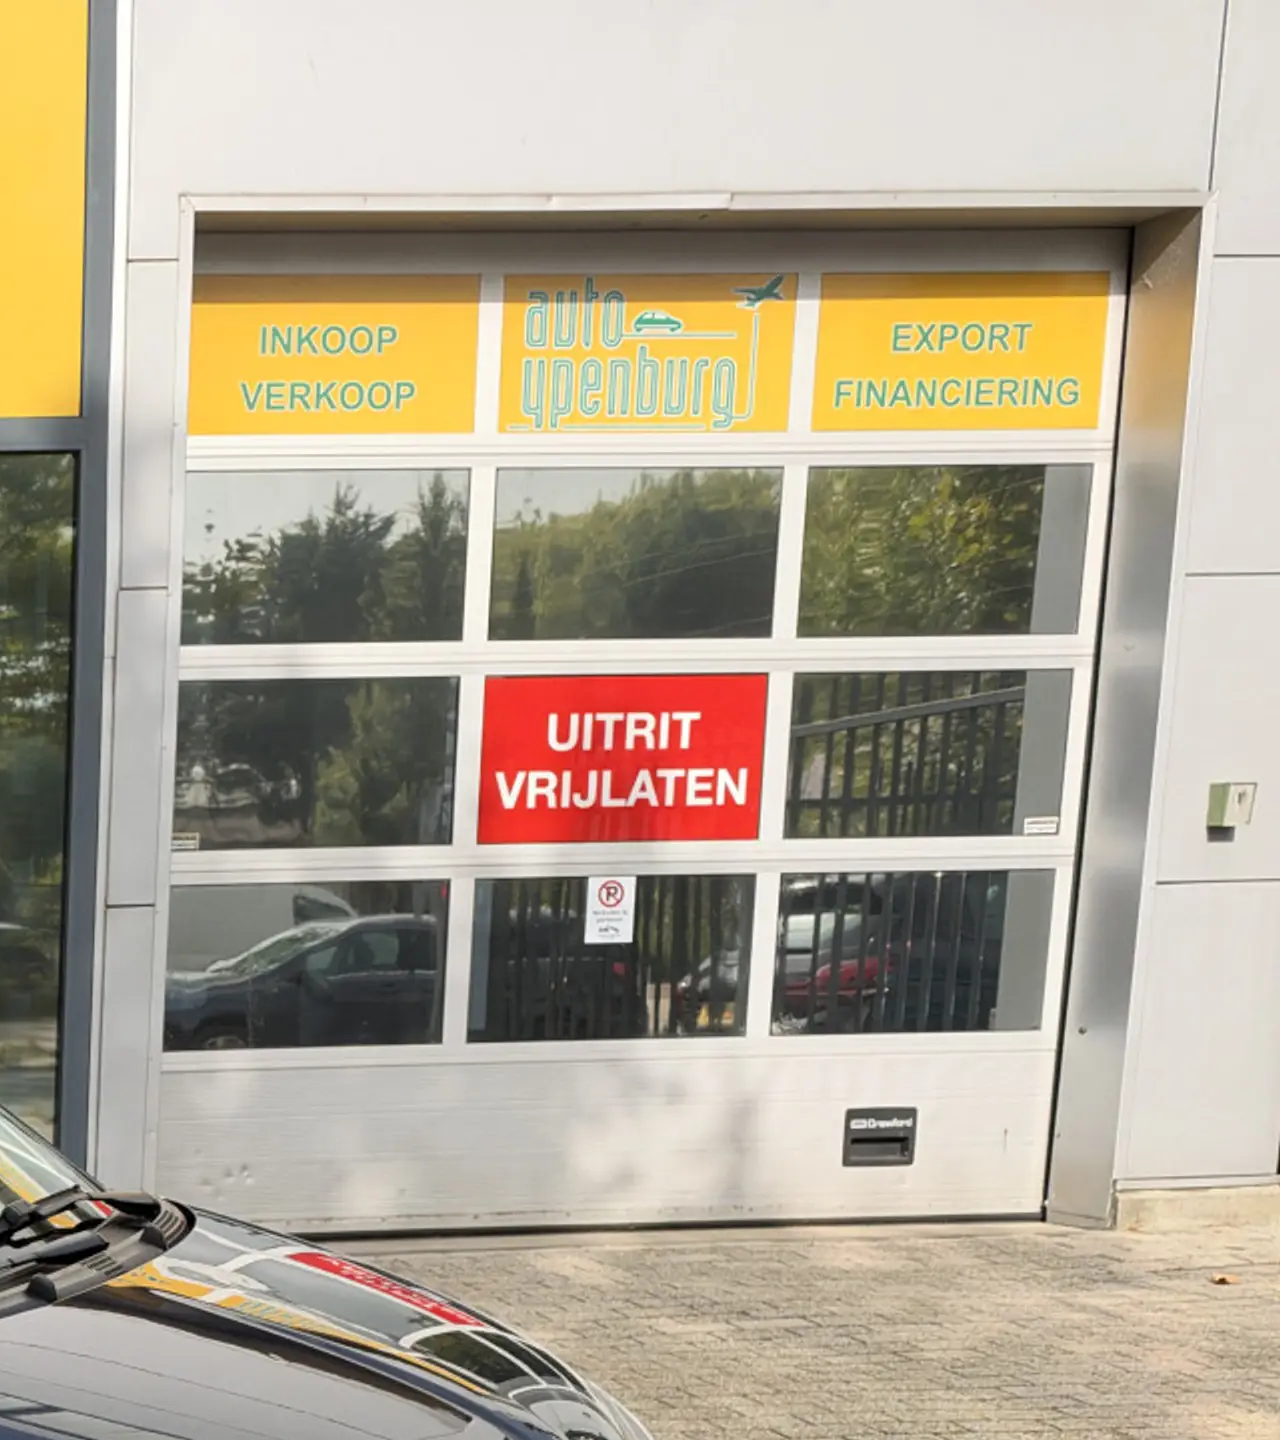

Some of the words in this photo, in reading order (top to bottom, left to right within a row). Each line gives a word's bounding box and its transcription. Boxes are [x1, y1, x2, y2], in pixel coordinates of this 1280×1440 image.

[525, 277, 627, 348] auto
[258, 323, 400, 357] INKOOP
[890, 321, 1033, 355] EXPORT
[240, 379, 417, 413] VERKOOP
[521, 344, 737, 431] ypenburg
[833, 374, 1081, 411] FINANCIERING
[546, 711, 702, 753] UITRIT
[495, 766, 749, 812] VRIJLATEN
